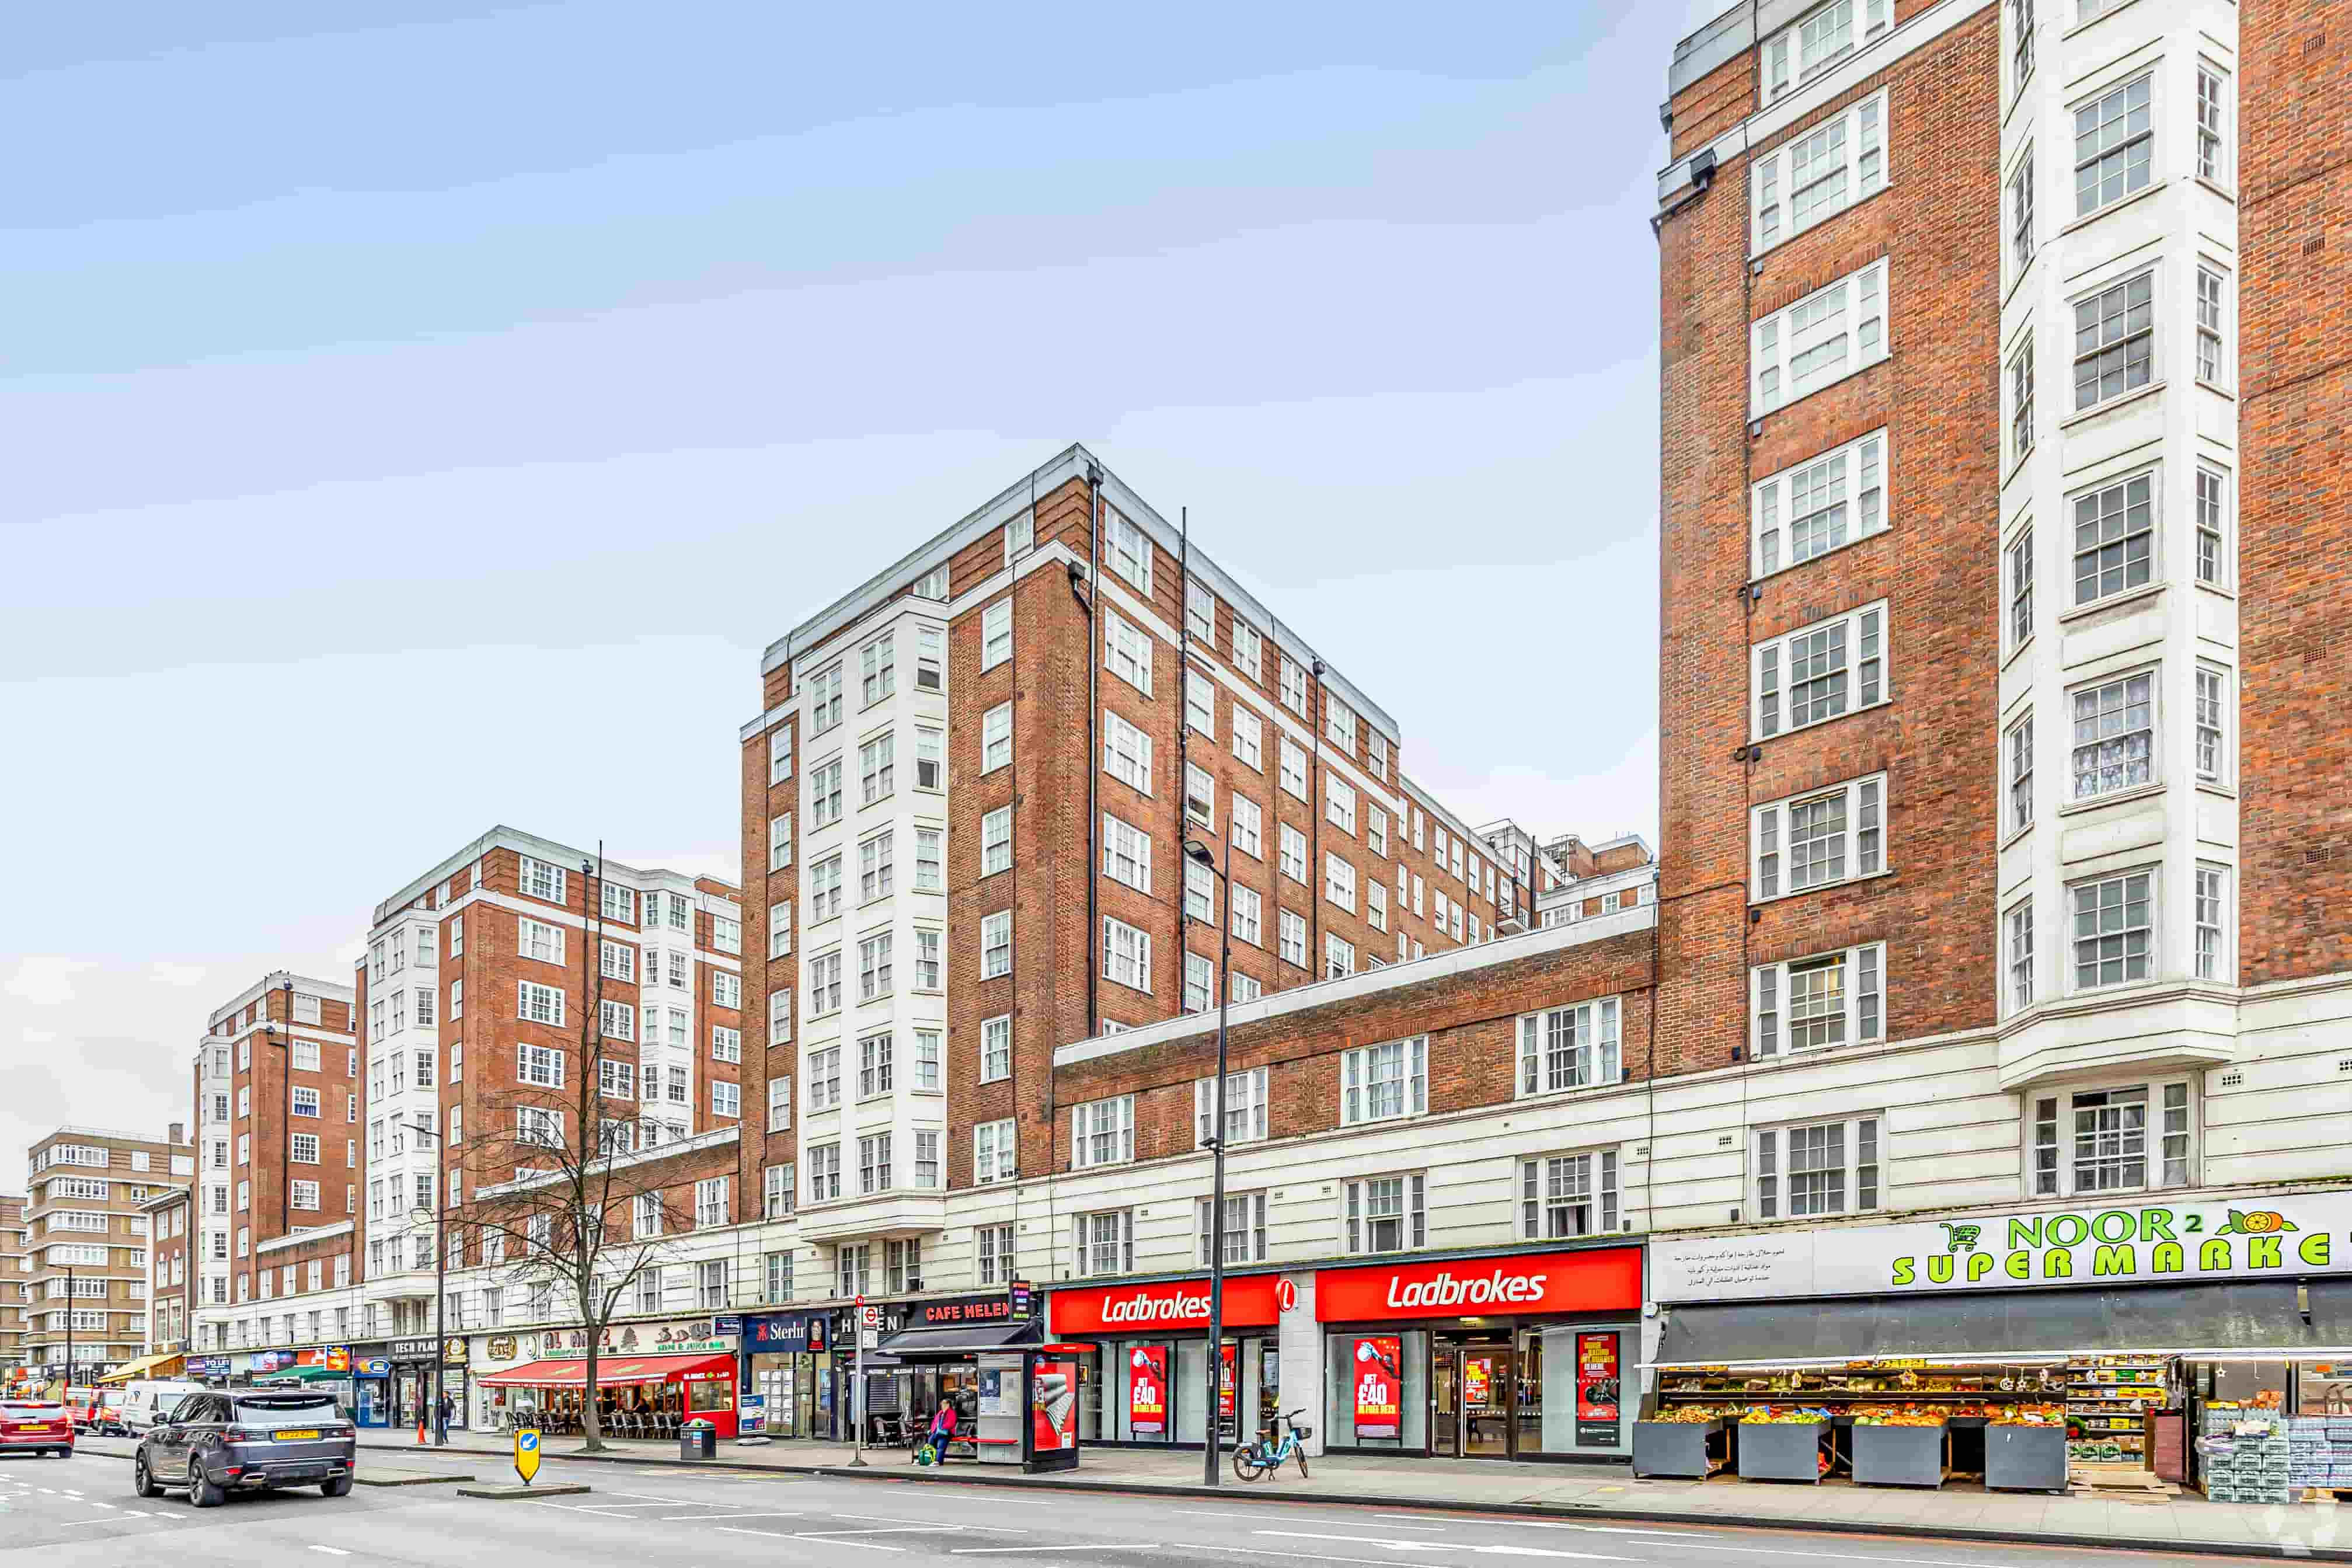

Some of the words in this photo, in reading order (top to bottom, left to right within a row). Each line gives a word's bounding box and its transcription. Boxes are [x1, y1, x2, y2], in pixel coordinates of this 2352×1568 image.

[2008, 1209, 2177, 1249] NOOR
[2185, 1214, 2204, 1233] 2
[1892, 1231, 2352, 1285] SUPERMARKE
[1387, 1269, 1546, 1308] Ladbrokes
[926, 1306, 962, 1320] CAFE
[964, 1302, 1009, 1318] HELEN
[1102, 1291, 1212, 1322] Ladbrokes
[395, 1343, 415, 1353] TECH
[1364, 1374, 1377, 1384] GET
[1134, 1386, 1155, 1405] £40
[1358, 1384, 1387, 1405] £40
